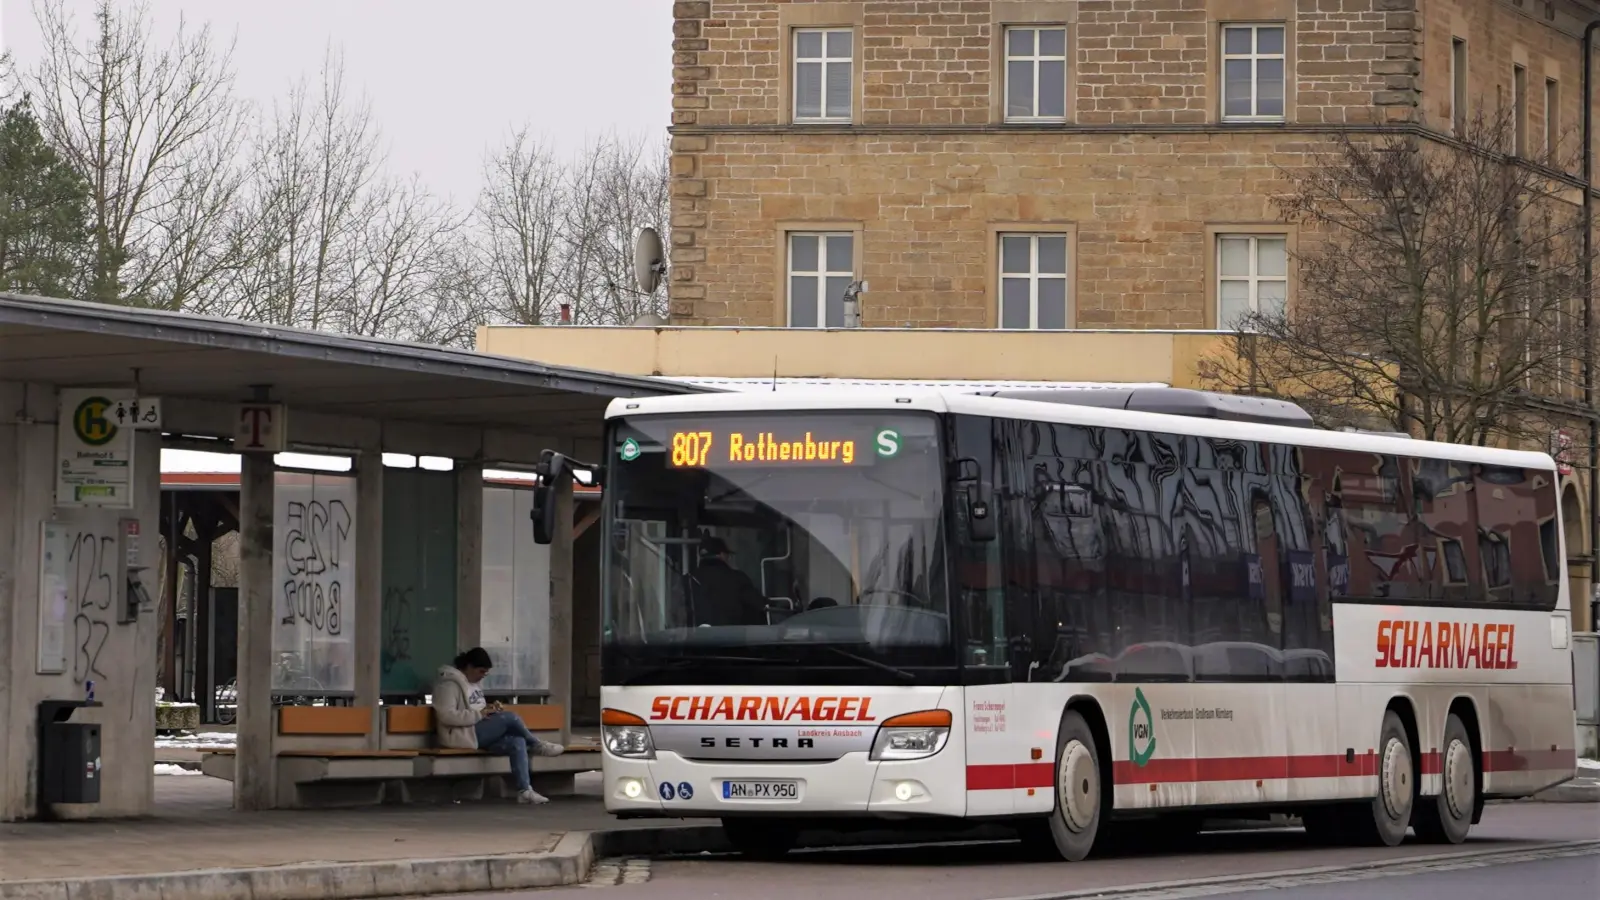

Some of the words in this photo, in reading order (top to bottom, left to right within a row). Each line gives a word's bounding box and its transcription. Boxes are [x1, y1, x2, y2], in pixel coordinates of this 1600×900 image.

[672, 432, 712, 466] 807
[729, 432, 854, 463] Rothenburg
[876, 430, 898, 455] S
[69, 531, 115, 612] 125
[1375, 620, 1518, 669] SCHARNAGEL
[650, 696, 876, 721] SCHARNAGEL
[700, 737, 814, 748] SETRA
[797, 729, 831, 737] Landkreis
[833, 729, 863, 737] Ansbach
[1133, 724, 1148, 739] VGN
[731, 784, 746, 797] AN
[755, 784, 770, 797] PX
[773, 783, 796, 797] 950
